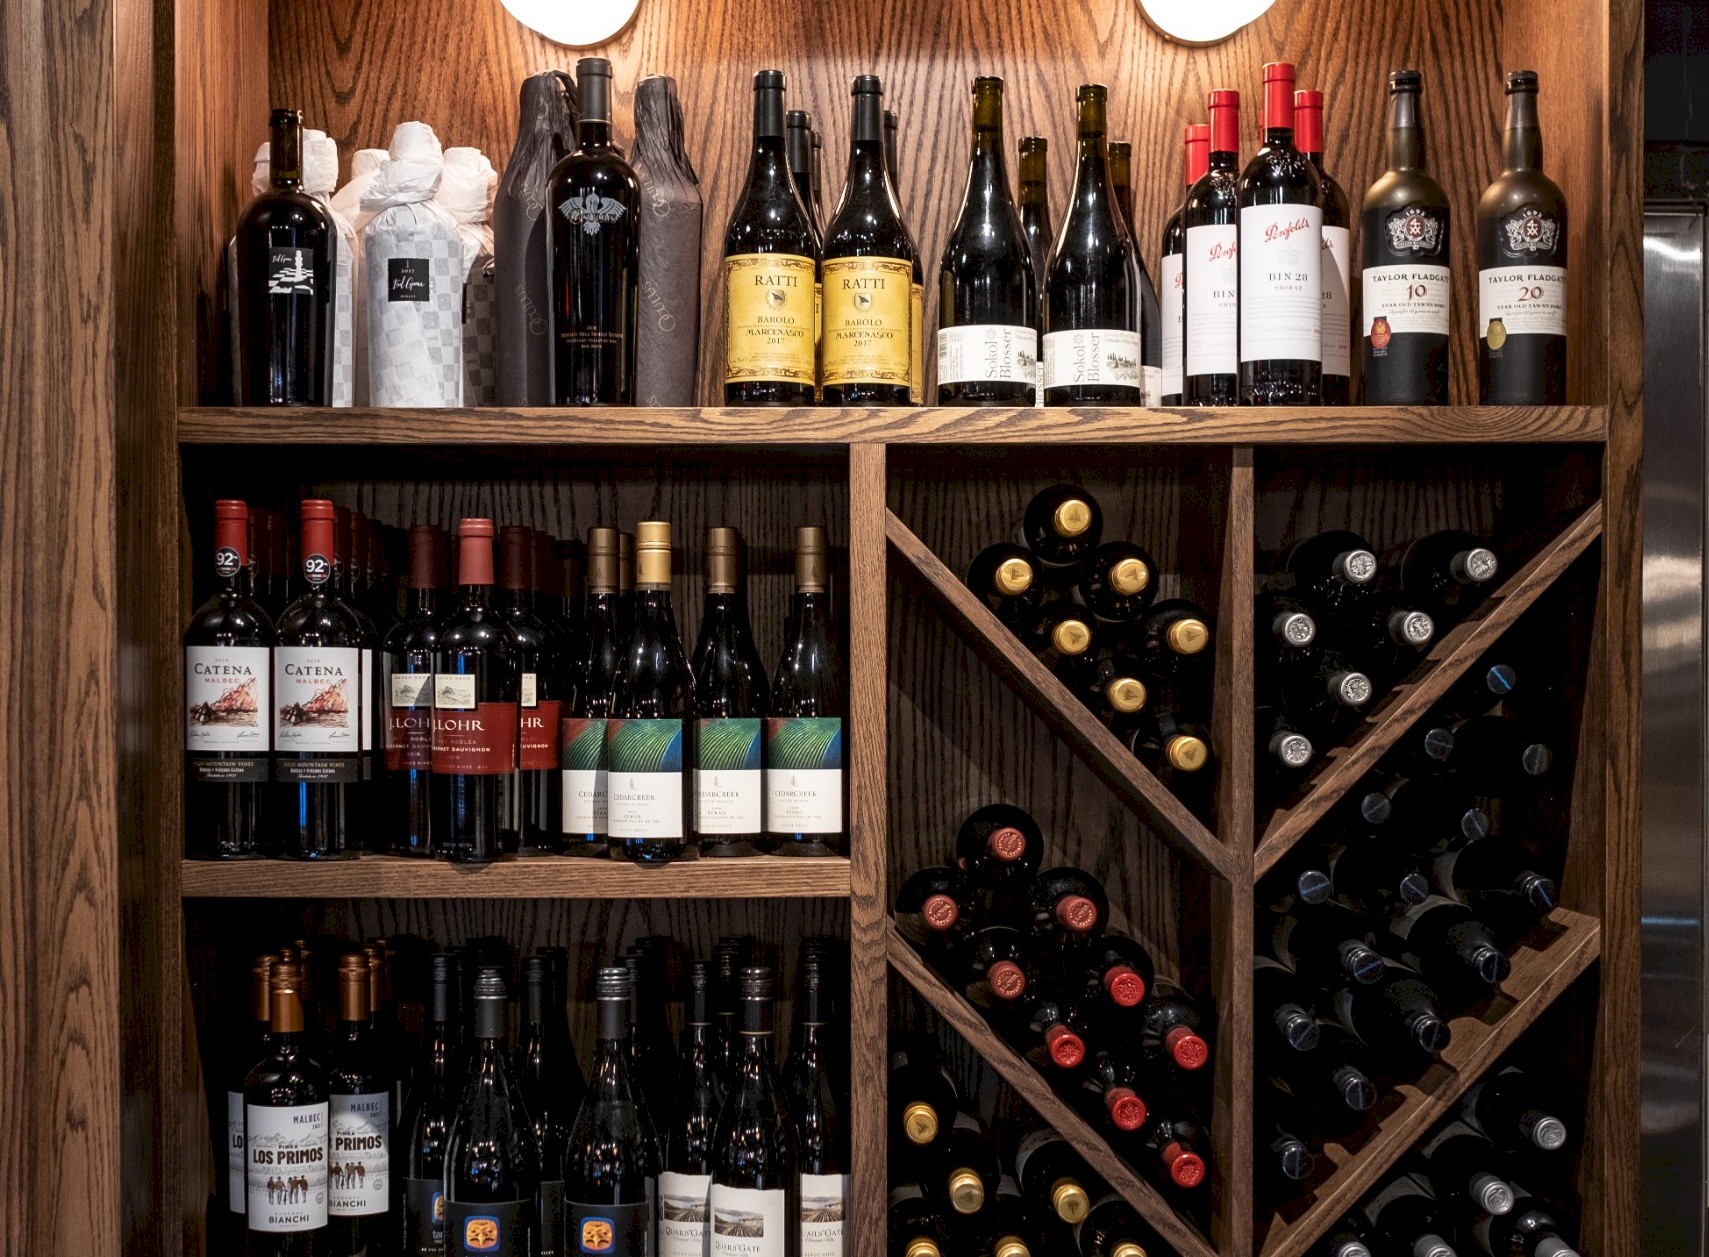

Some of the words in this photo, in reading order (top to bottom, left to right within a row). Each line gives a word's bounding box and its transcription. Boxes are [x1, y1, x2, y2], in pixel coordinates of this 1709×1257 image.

[1265, 217, 1310, 243] Penfolds
[755, 274, 798, 288] RATTI
[1269, 273, 1292, 281] BIN
[1295, 273, 1308, 281] 28
[1373, 274, 1408, 283] TAYLOR
[1489, 274, 1524, 284] TAYLOR
[843, 279, 885, 290] RATTI
[1213, 290, 1236, 299] BIN
[1407, 284, 1427, 300] 10
[1517, 286, 1544, 302] 20
[757, 316, 795, 325] BAROLO
[845, 318, 883, 327] BAROLO
[746, 328, 805, 338] MARCENASCO
[836, 331, 894, 341] MARCENASCO
[767, 337, 785, 345] 2017
[854, 339, 872, 348] 2017
[1000, 328, 1012, 378] Blosser
[1087, 332, 1100, 382] Blosser
[985, 341, 998, 378] Sokol
[1073, 345, 1086, 383] Sokol
[216, 553, 234, 566] 92
[306, 560, 325, 573] 92
[194, 663, 252, 675] CATENA
[285, 664, 343, 676] CATENA
[432, 720, 485, 733] J.LOHR
[350, 1102, 379, 1113] MALBEC
[293, 1113, 321, 1125] MALBEC
[335, 1135, 382, 1151] PRIMOS
[253, 1149, 274, 1165] LOS
[276, 1147, 323, 1165] PRIMOS
[268, 1214, 310, 1224] BIANCHI
